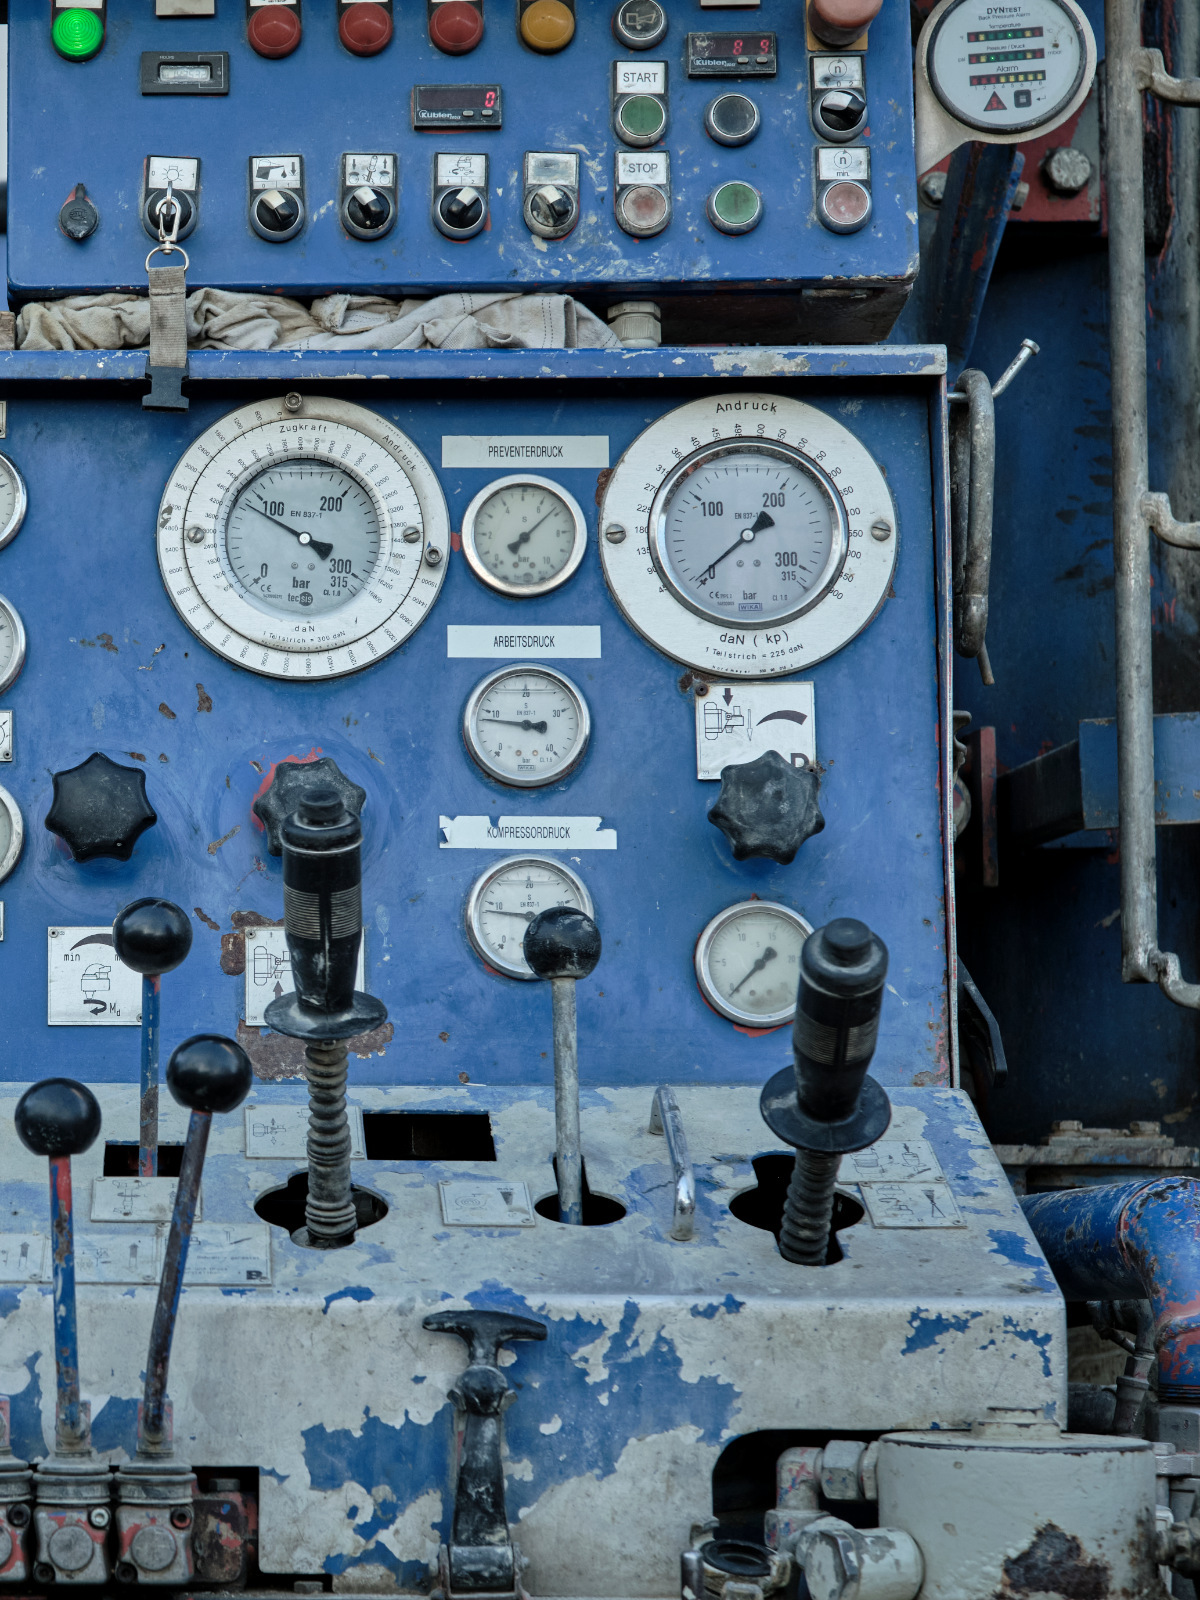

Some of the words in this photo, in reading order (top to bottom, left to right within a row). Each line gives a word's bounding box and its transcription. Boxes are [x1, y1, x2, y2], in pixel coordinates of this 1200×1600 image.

[986, 6, 1022, 15] DYNTEST
[732, 39, 744, 56] 8
[759, 39, 769, 55] 9
[834, 64, 842, 74] n
[996, 65, 1019, 73] Alarm
[623, 72, 659, 83] START
[484, 91, 496, 108] 0
[840, 155, 847, 165] n
[628, 163, 658, 174] STOP
[715, 401, 778, 414] Andruck
[279, 423, 327, 433] Zugkraft
[197, 444, 211, 457] 2400
[341, 444, 352, 460] 10200
[382, 434, 417, 472] Andruck
[488, 445, 564, 458] PREVENTERDRUCK
[365, 463, 379, 476] 11400
[374, 475, 390, 488] 12000
[209, 497, 223, 505] 4200
[320, 496, 342, 512] 200
[762, 493, 786, 508] 200
[263, 501, 285, 516] 100
[387, 505, 404, 514] 13200
[701, 501, 723, 517] 100
[303, 511, 323, 519] 837-1
[774, 551, 798, 567] 300
[329, 559, 351, 574] 300
[213, 571, 226, 580] 1200
[781, 571, 797, 581] 315
[292, 577, 310, 589] bar
[330, 576, 348, 588] 315
[287, 592, 313, 606] tecsis
[743, 591, 757, 600] bar
[188, 603, 201, 615] 7200
[740, 603, 760, 611] WIKA
[295, 624, 315, 633] daN
[493, 635, 555, 648] ARBEITSDRUCK
[720, 632, 746, 645] daN
[713, 648, 757, 660] Teilstrich
[770, 650, 786, 659] 225
[789, 643, 804, 653] daN
[491, 710, 500, 718] 10
[552, 709, 561, 718] 30
[545, 744, 554, 752] 40
[486, 826, 571, 839] KOMPRESSORDRUCK
[768, 932, 777, 941] 15
[63, 953, 80, 962] min
